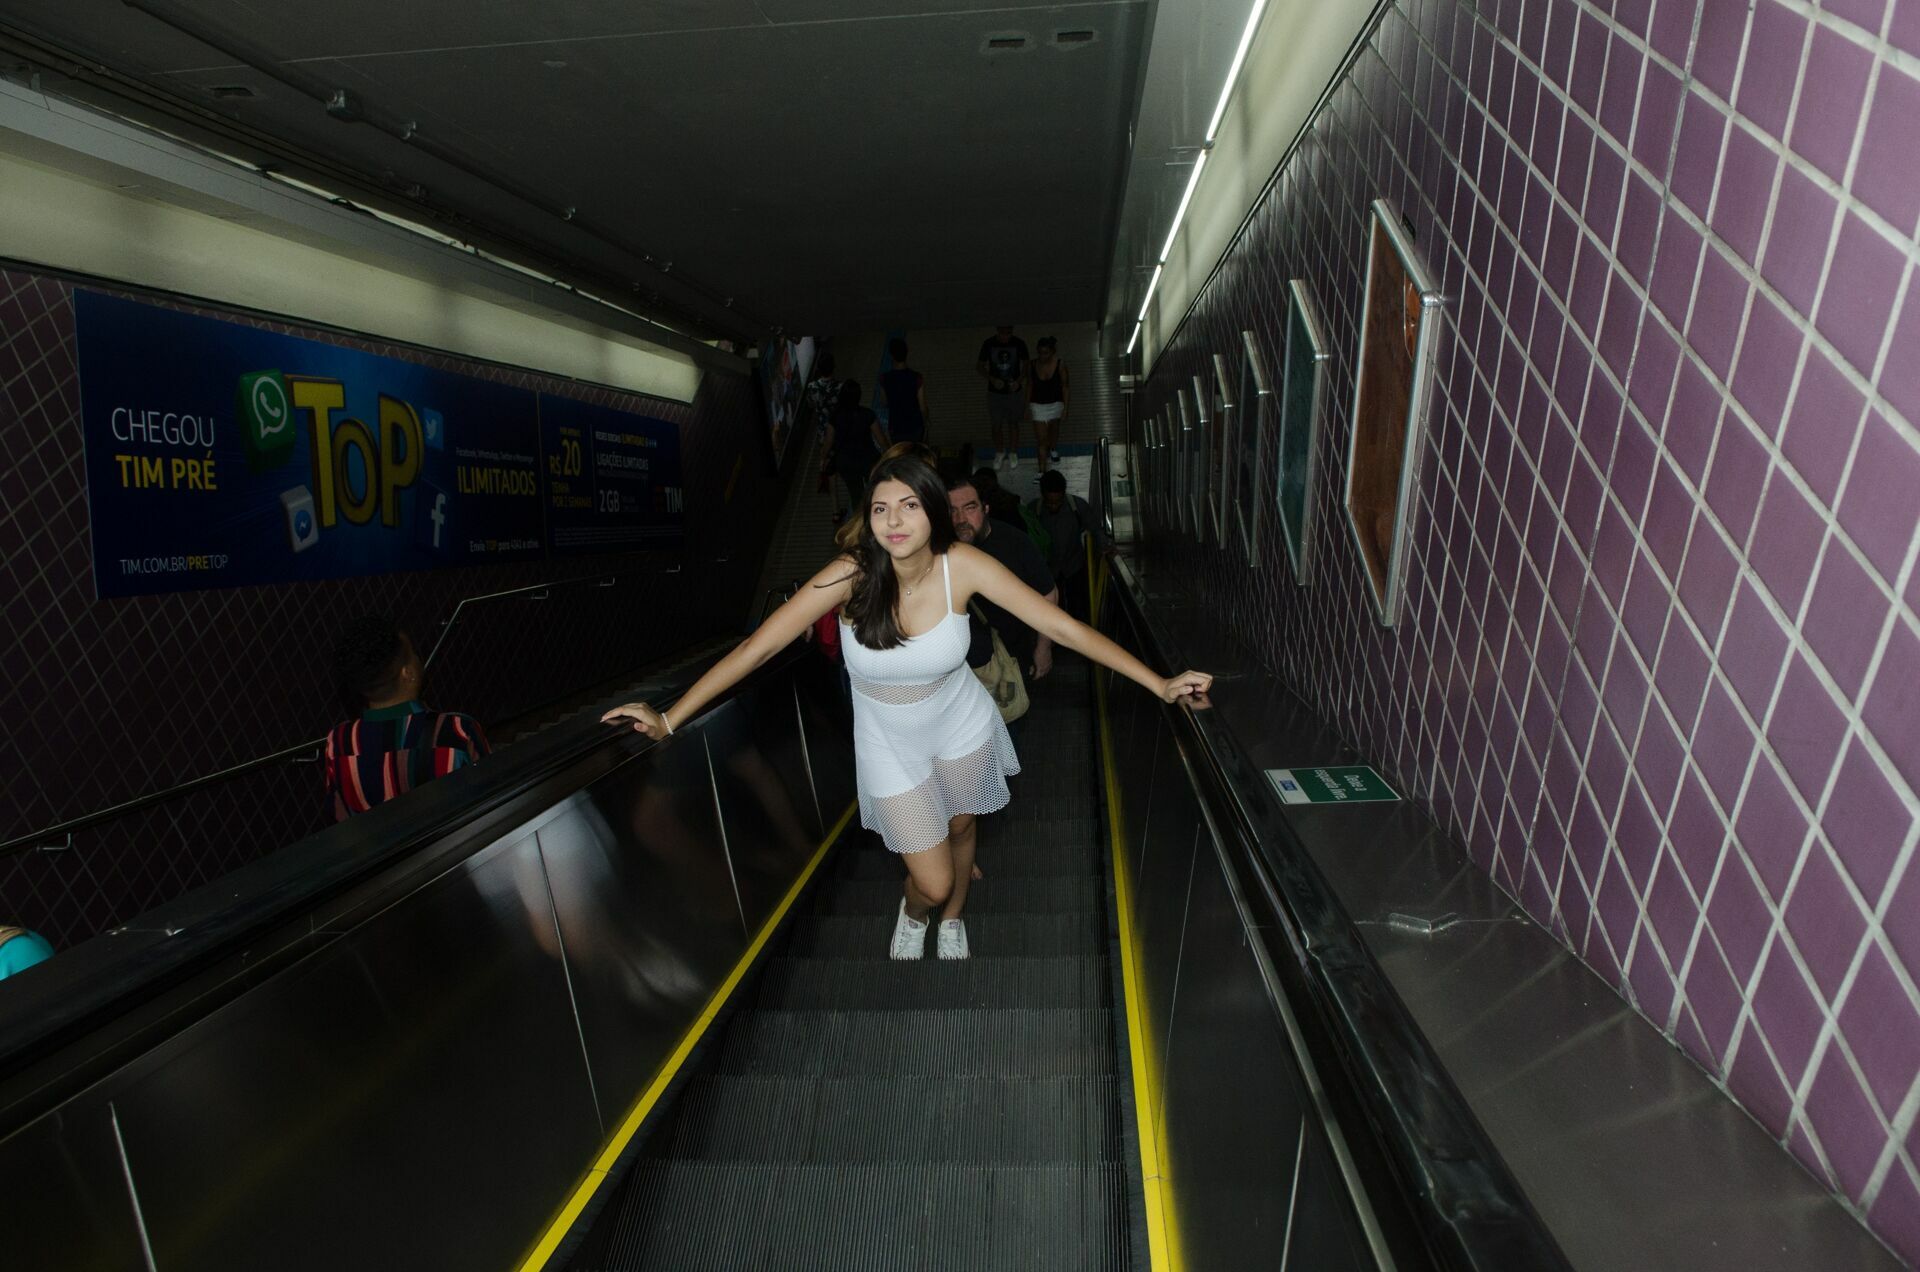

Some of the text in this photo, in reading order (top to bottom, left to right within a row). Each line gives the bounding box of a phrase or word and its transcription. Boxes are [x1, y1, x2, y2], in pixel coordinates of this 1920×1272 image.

[111, 407, 216, 448] CHEGOU
[114, 450, 218, 491] TIM PRÉ
[561, 438, 581, 477] 20
[456, 465, 537, 497] ILIMITADOS
[665, 486, 683, 513] TIM
[119, 554, 229, 575] TIM.COM.BR/PRETOP
